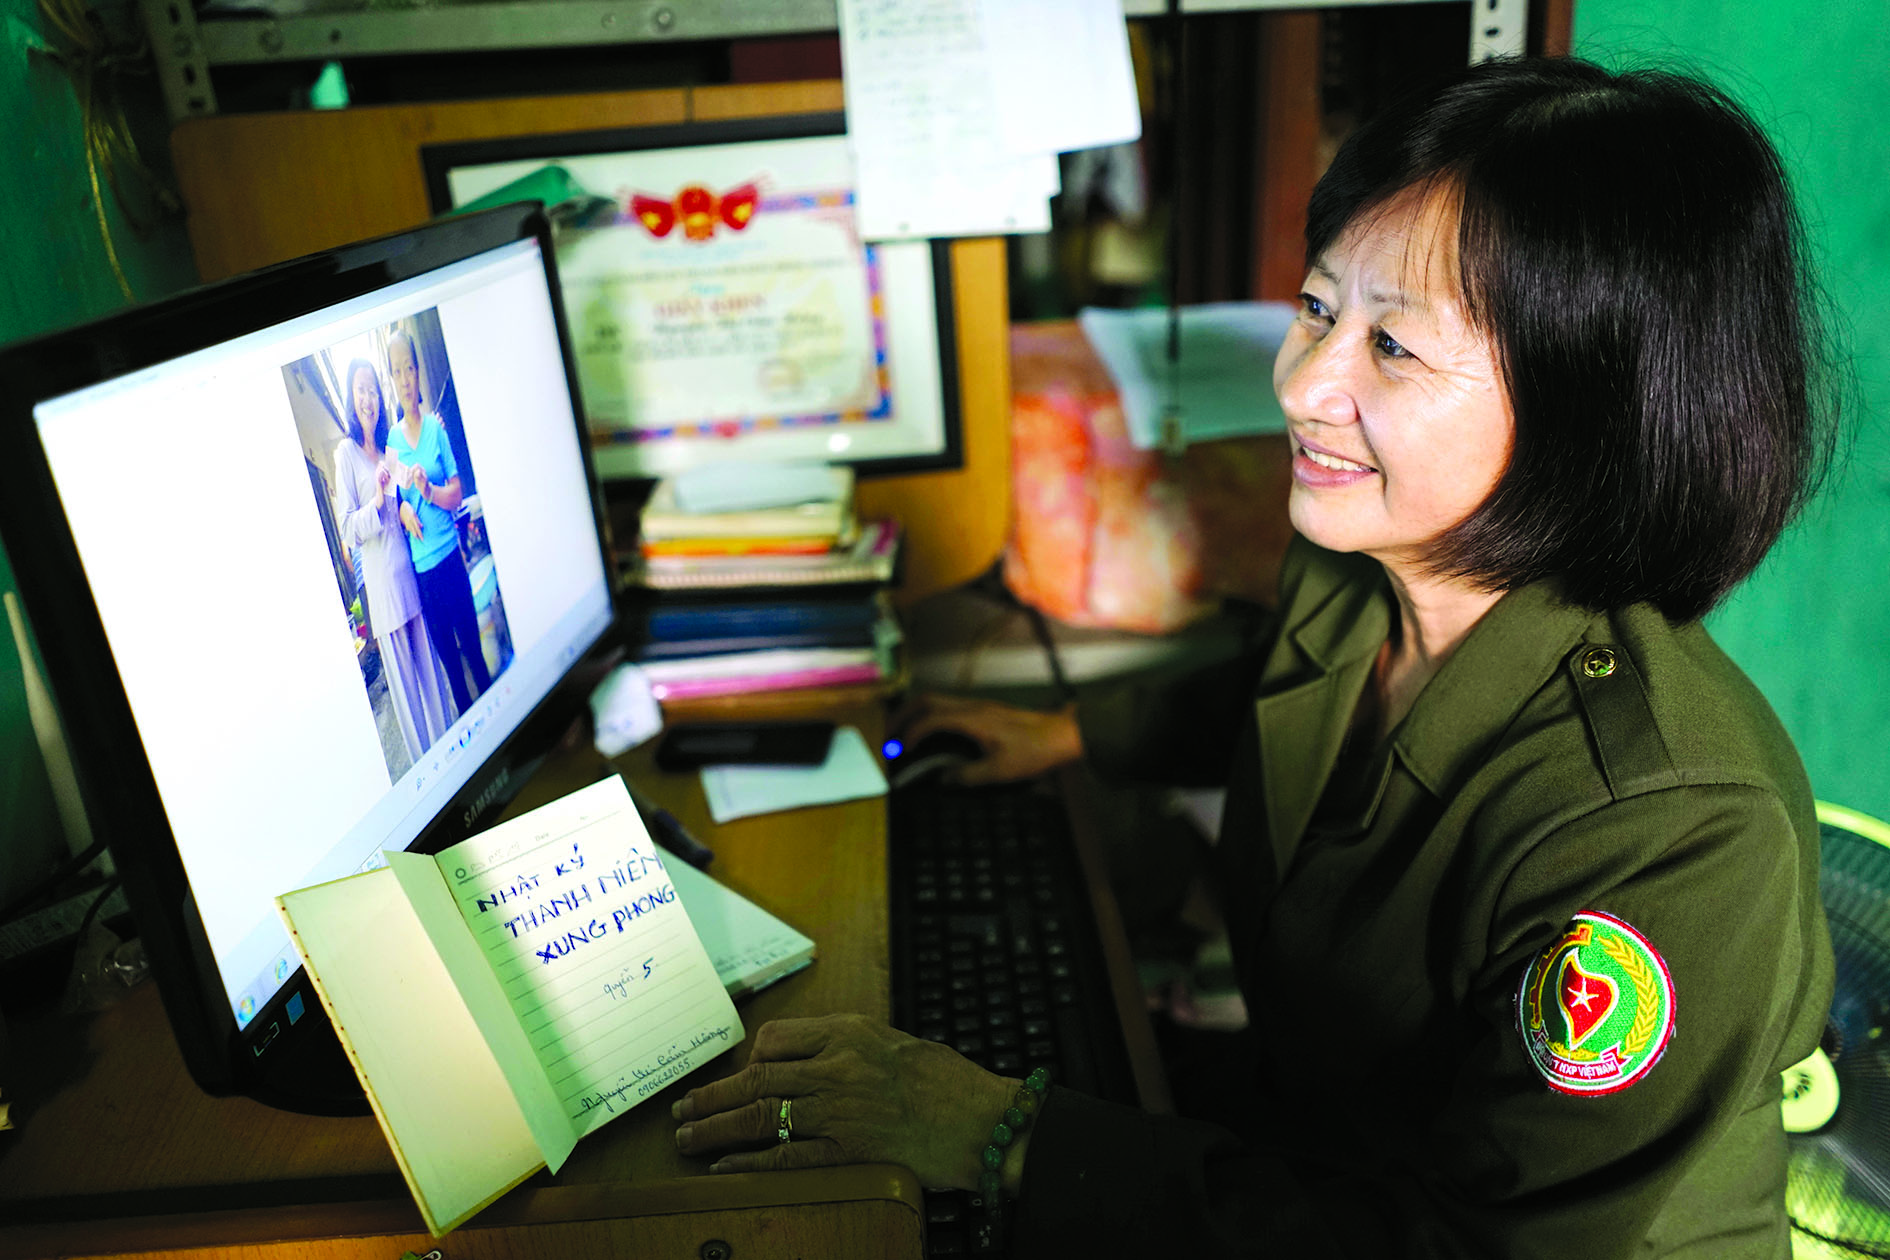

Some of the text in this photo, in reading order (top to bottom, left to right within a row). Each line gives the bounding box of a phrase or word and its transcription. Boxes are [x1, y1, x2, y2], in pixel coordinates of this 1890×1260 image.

[464, 767, 509, 828] SAMSUNG
[476, 874, 540, 913] NHẬT
[503, 884, 592, 938] THANH
[535, 883, 675, 965] XUNG PHONG
